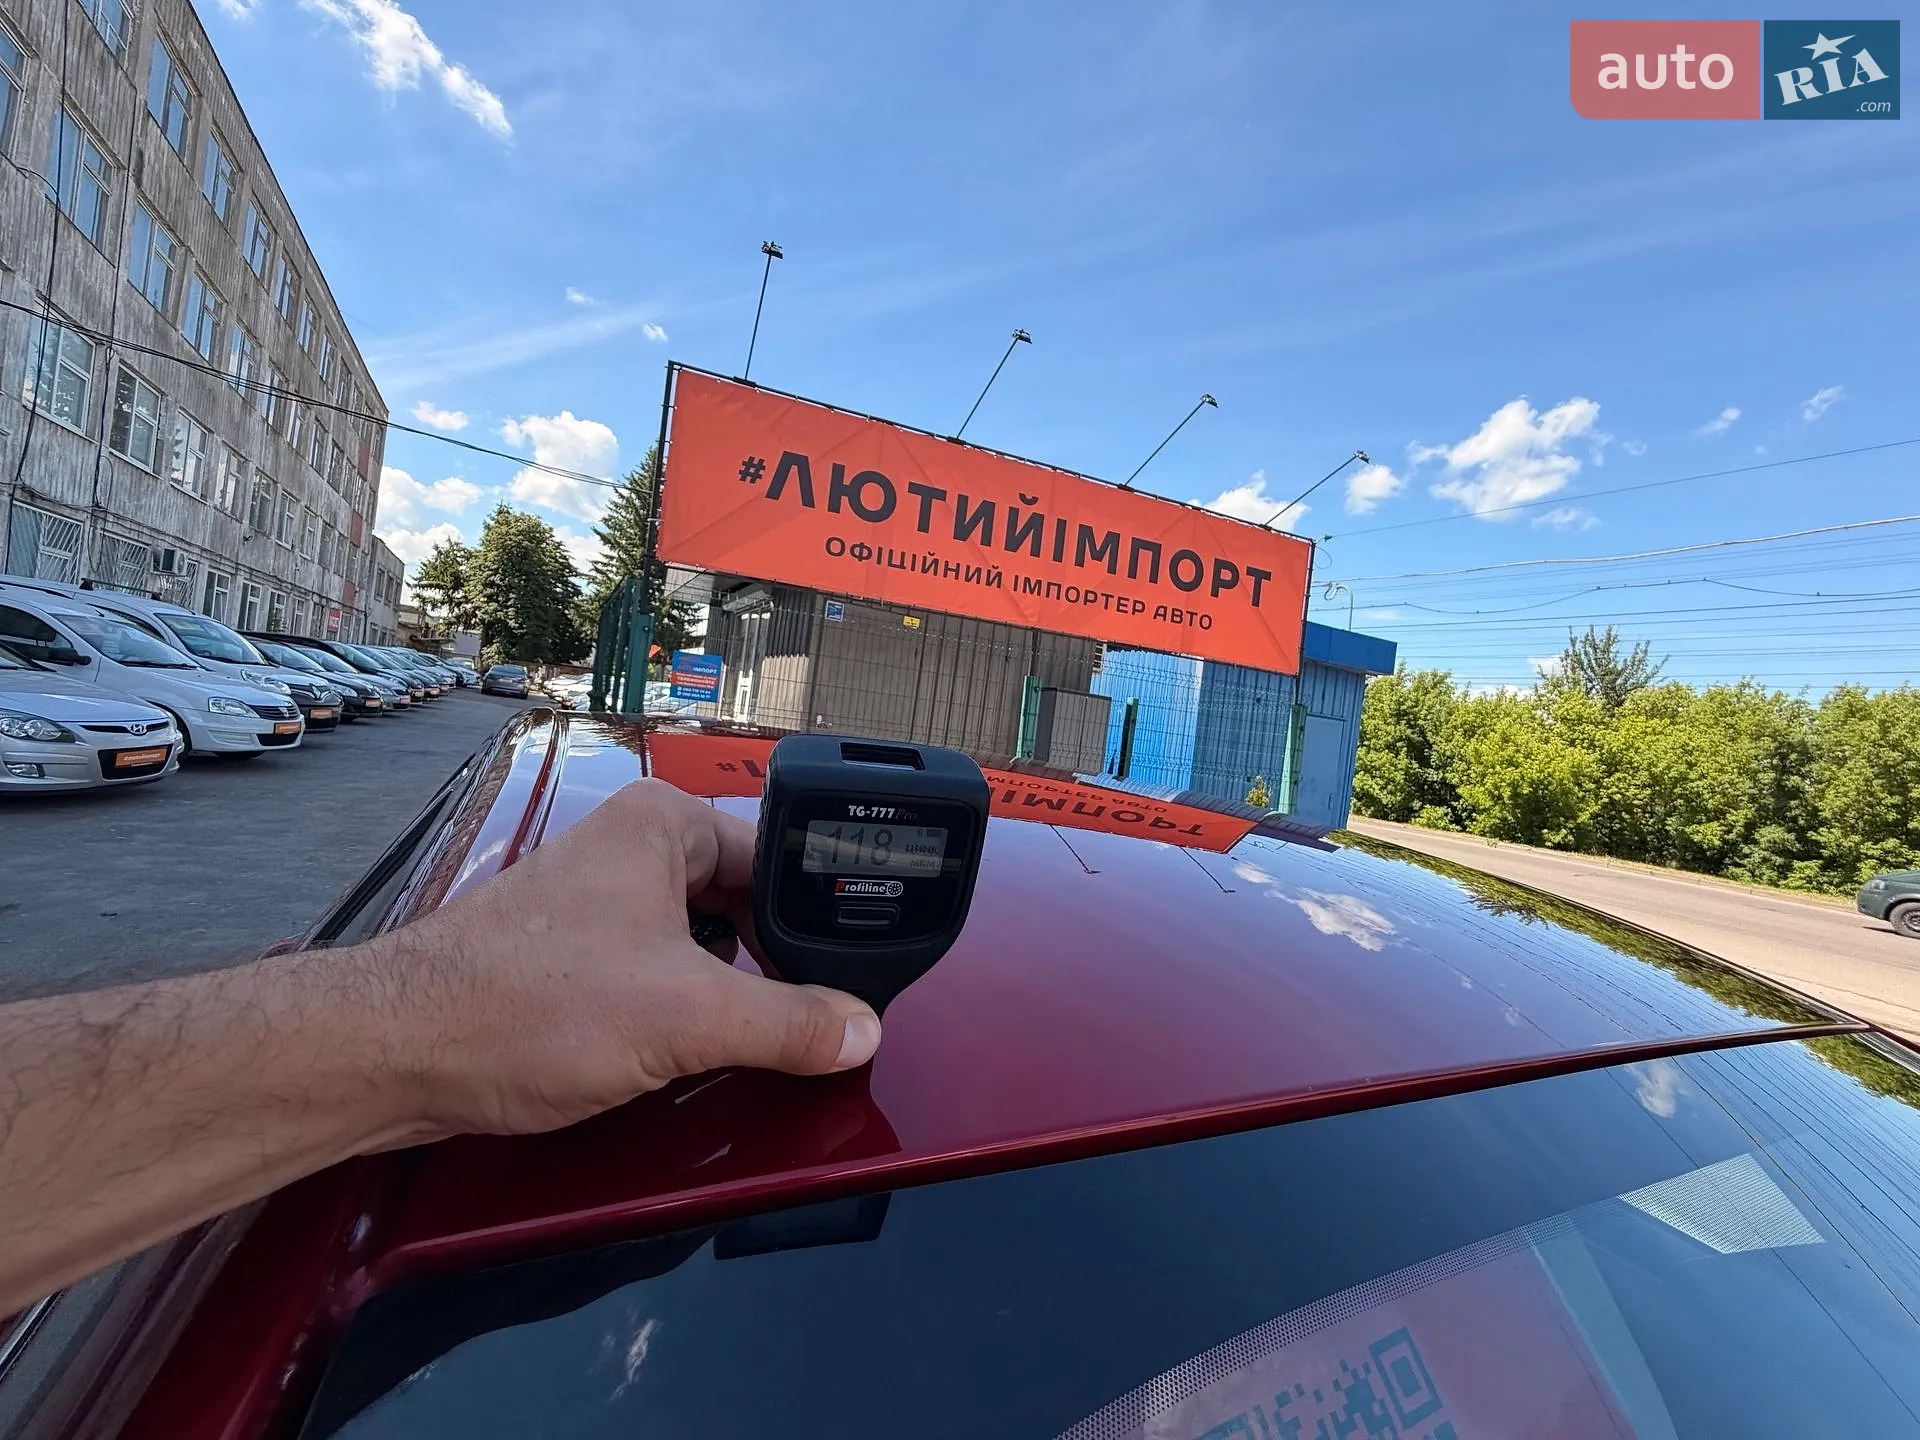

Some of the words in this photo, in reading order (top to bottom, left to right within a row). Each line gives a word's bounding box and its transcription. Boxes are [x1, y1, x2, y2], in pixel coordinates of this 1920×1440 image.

[738, 450, 1272, 608] #ЛЮТИЙІМПОРТ
[826, 537, 1003, 590] ОФІЦІЙНИЙ
[1013, 574, 1146, 615] ІМПОРТЕР
[1153, 605, 1213, 630] АВТО
[848, 804, 895, 819] TG-777
[827, 824, 894, 866] 118
[835, 880, 887, 893] Profiline
